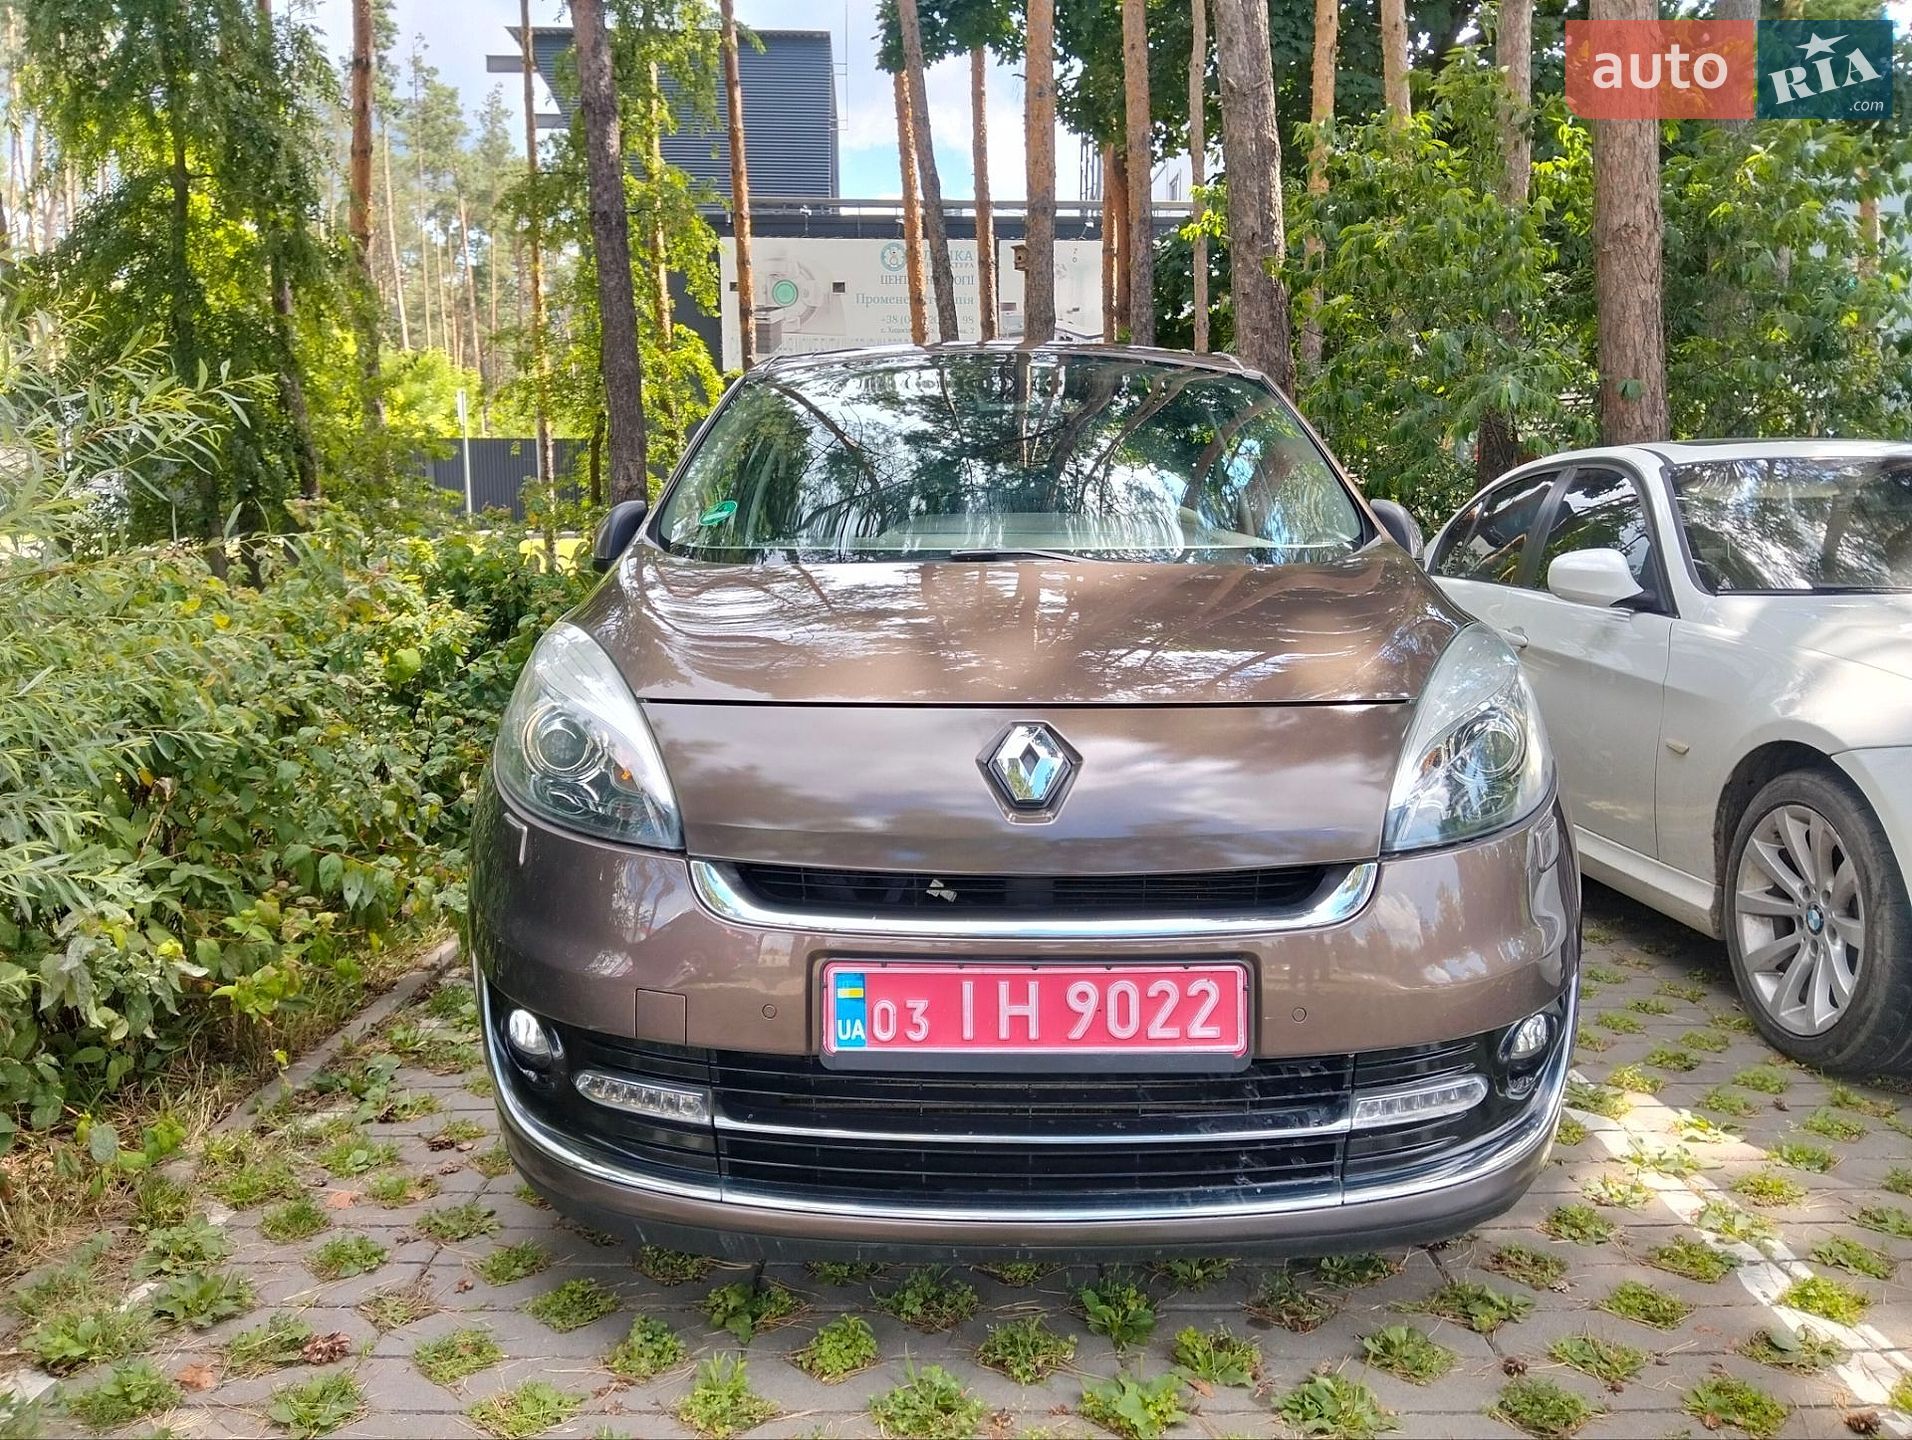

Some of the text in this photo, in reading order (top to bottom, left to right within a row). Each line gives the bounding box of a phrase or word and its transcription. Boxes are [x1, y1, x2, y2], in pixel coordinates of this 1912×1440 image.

[837, 1018, 866, 1041] UA
[871, 999, 929, 1042] 03
[1065, 979, 1221, 1040] 9022
